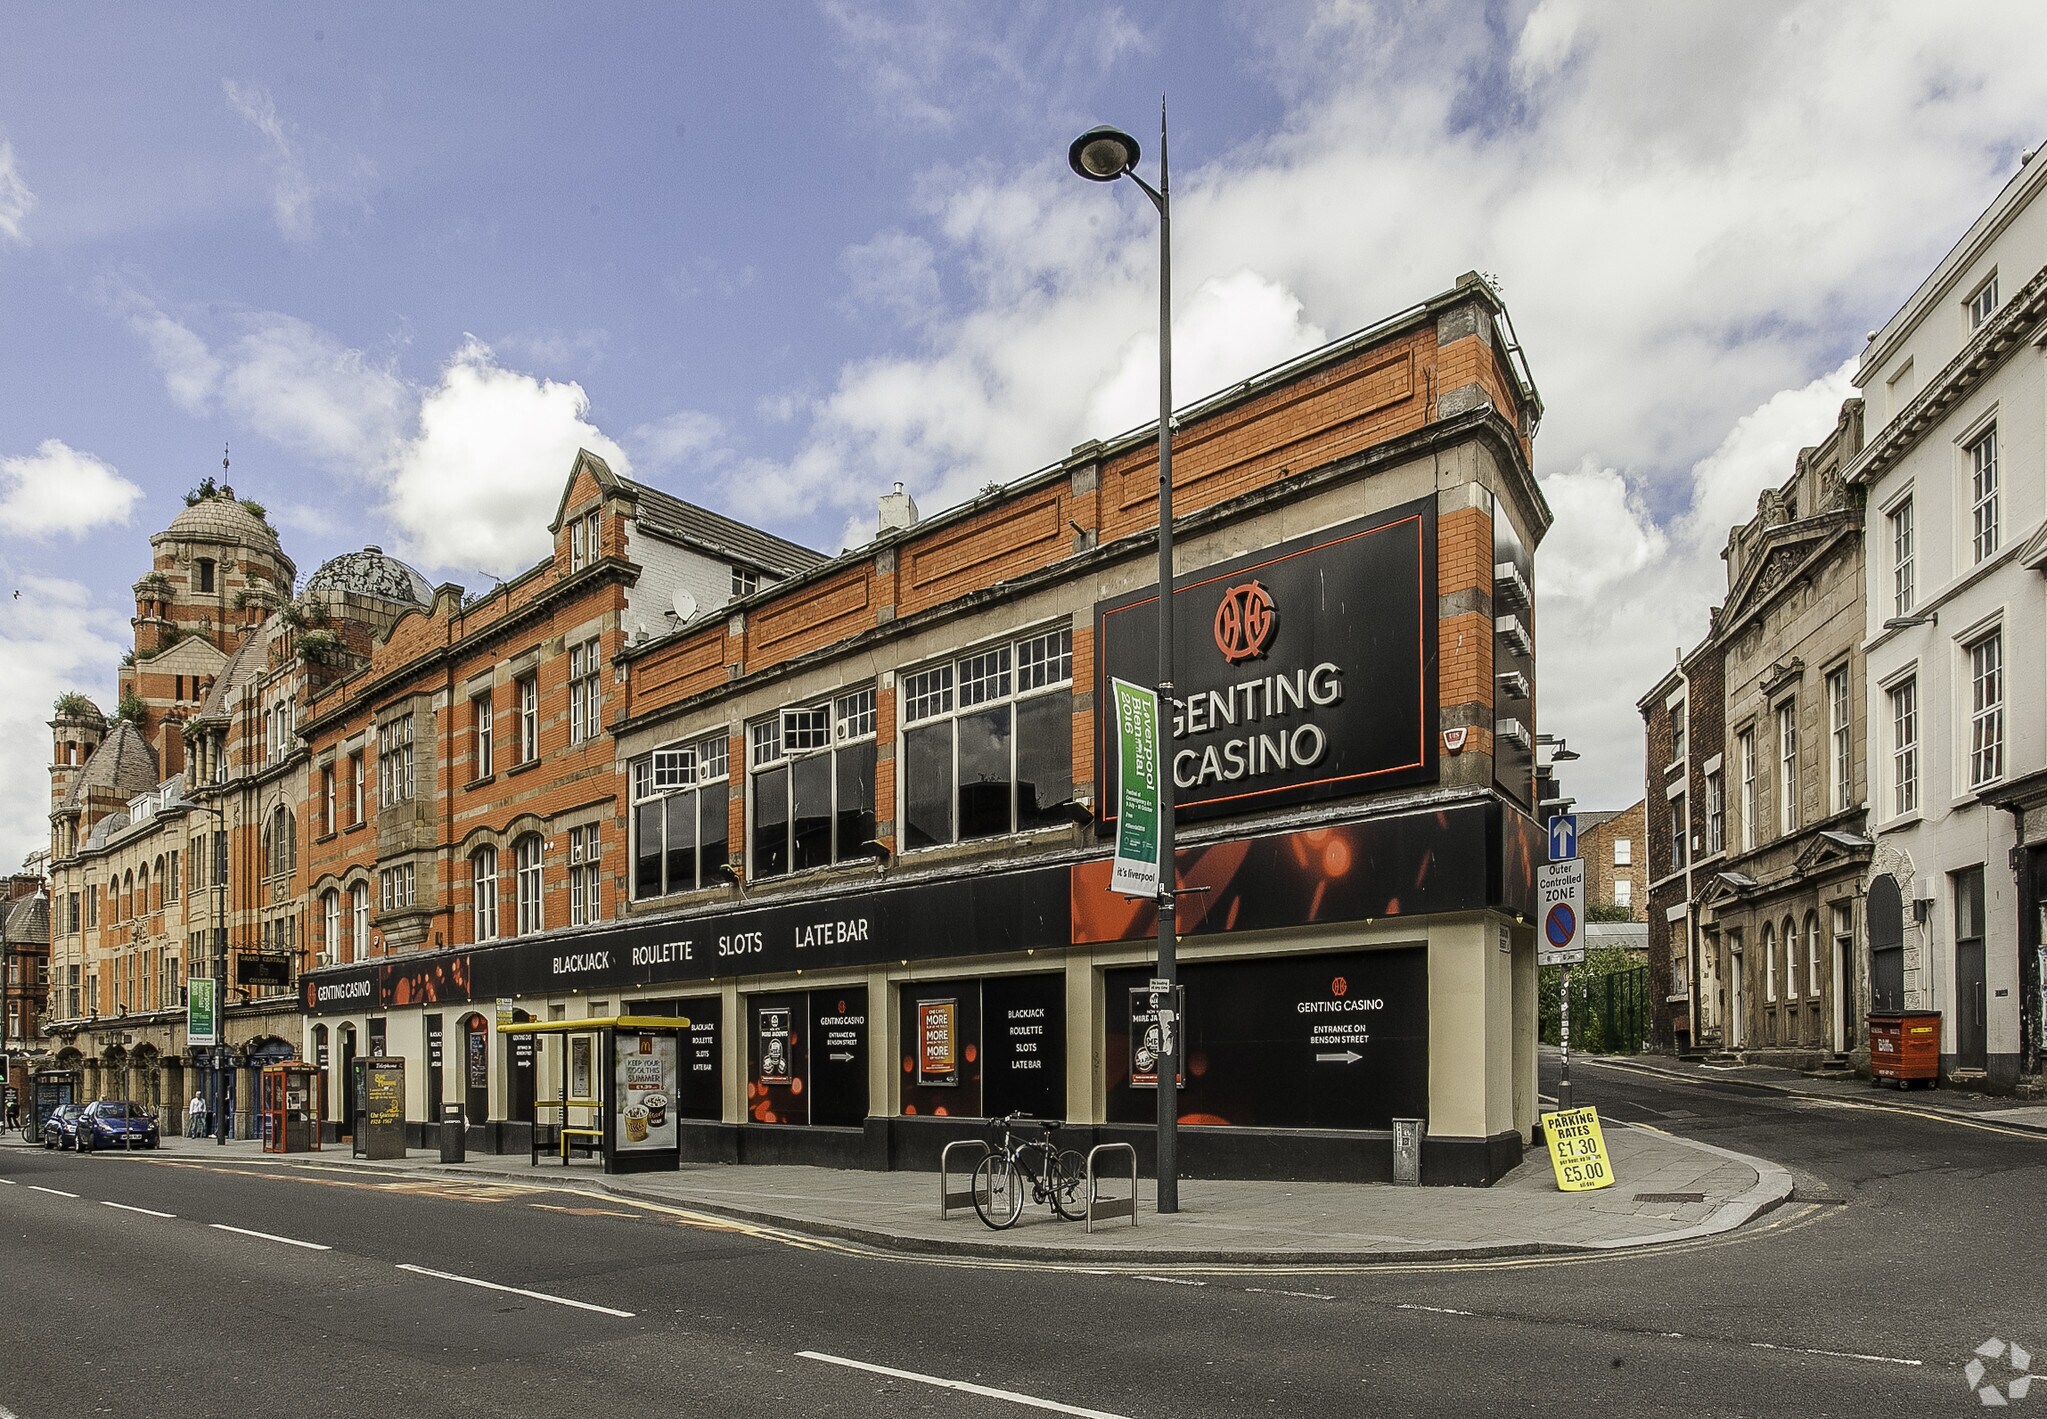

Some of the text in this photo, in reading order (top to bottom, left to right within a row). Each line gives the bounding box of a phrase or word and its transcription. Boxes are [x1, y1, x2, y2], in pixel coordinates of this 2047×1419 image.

[1121, 691, 1134, 735] 2016
[1174, 723, 1326, 788] CASINO
[1117, 867, 1155, 882] it's liverpool
[1549, 865, 1572, 875] Outer
[1540, 874, 1582, 889] Controlled
[1546, 887, 1575, 902] ZONE
[553, 918, 868, 974] BLACKJACK ROULETTE SLOTS LATE BAR
[318, 980, 370, 1001] GENTING CASINO
[1297, 999, 1384, 1013] GENTING CASINO
[926, 1014, 948, 1025] MORE
[1008, 1008, 1045, 1019] BLACKJACK
[820, 1016, 865, 1026] GENTING CASINO
[926, 1030, 948, 1041] MORE
[1010, 1026, 1043, 1035] ROULETTE
[1314, 1024, 1366, 1034] ENTRANCE ON
[1310, 1035, 1369, 1044] BENSON STREET
[927, 1046, 949, 1056] MORE
[1016, 1043, 1037, 1052] SLOTS
[1012, 1060, 1041, 1069] LATE BAR
[1548, 1112, 1595, 1129] PARKING
[1558, 1125, 1590, 1139] RATES
[1557, 1138, 1597, 1157] £130
[1564, 1162, 1604, 1182] £5.00
